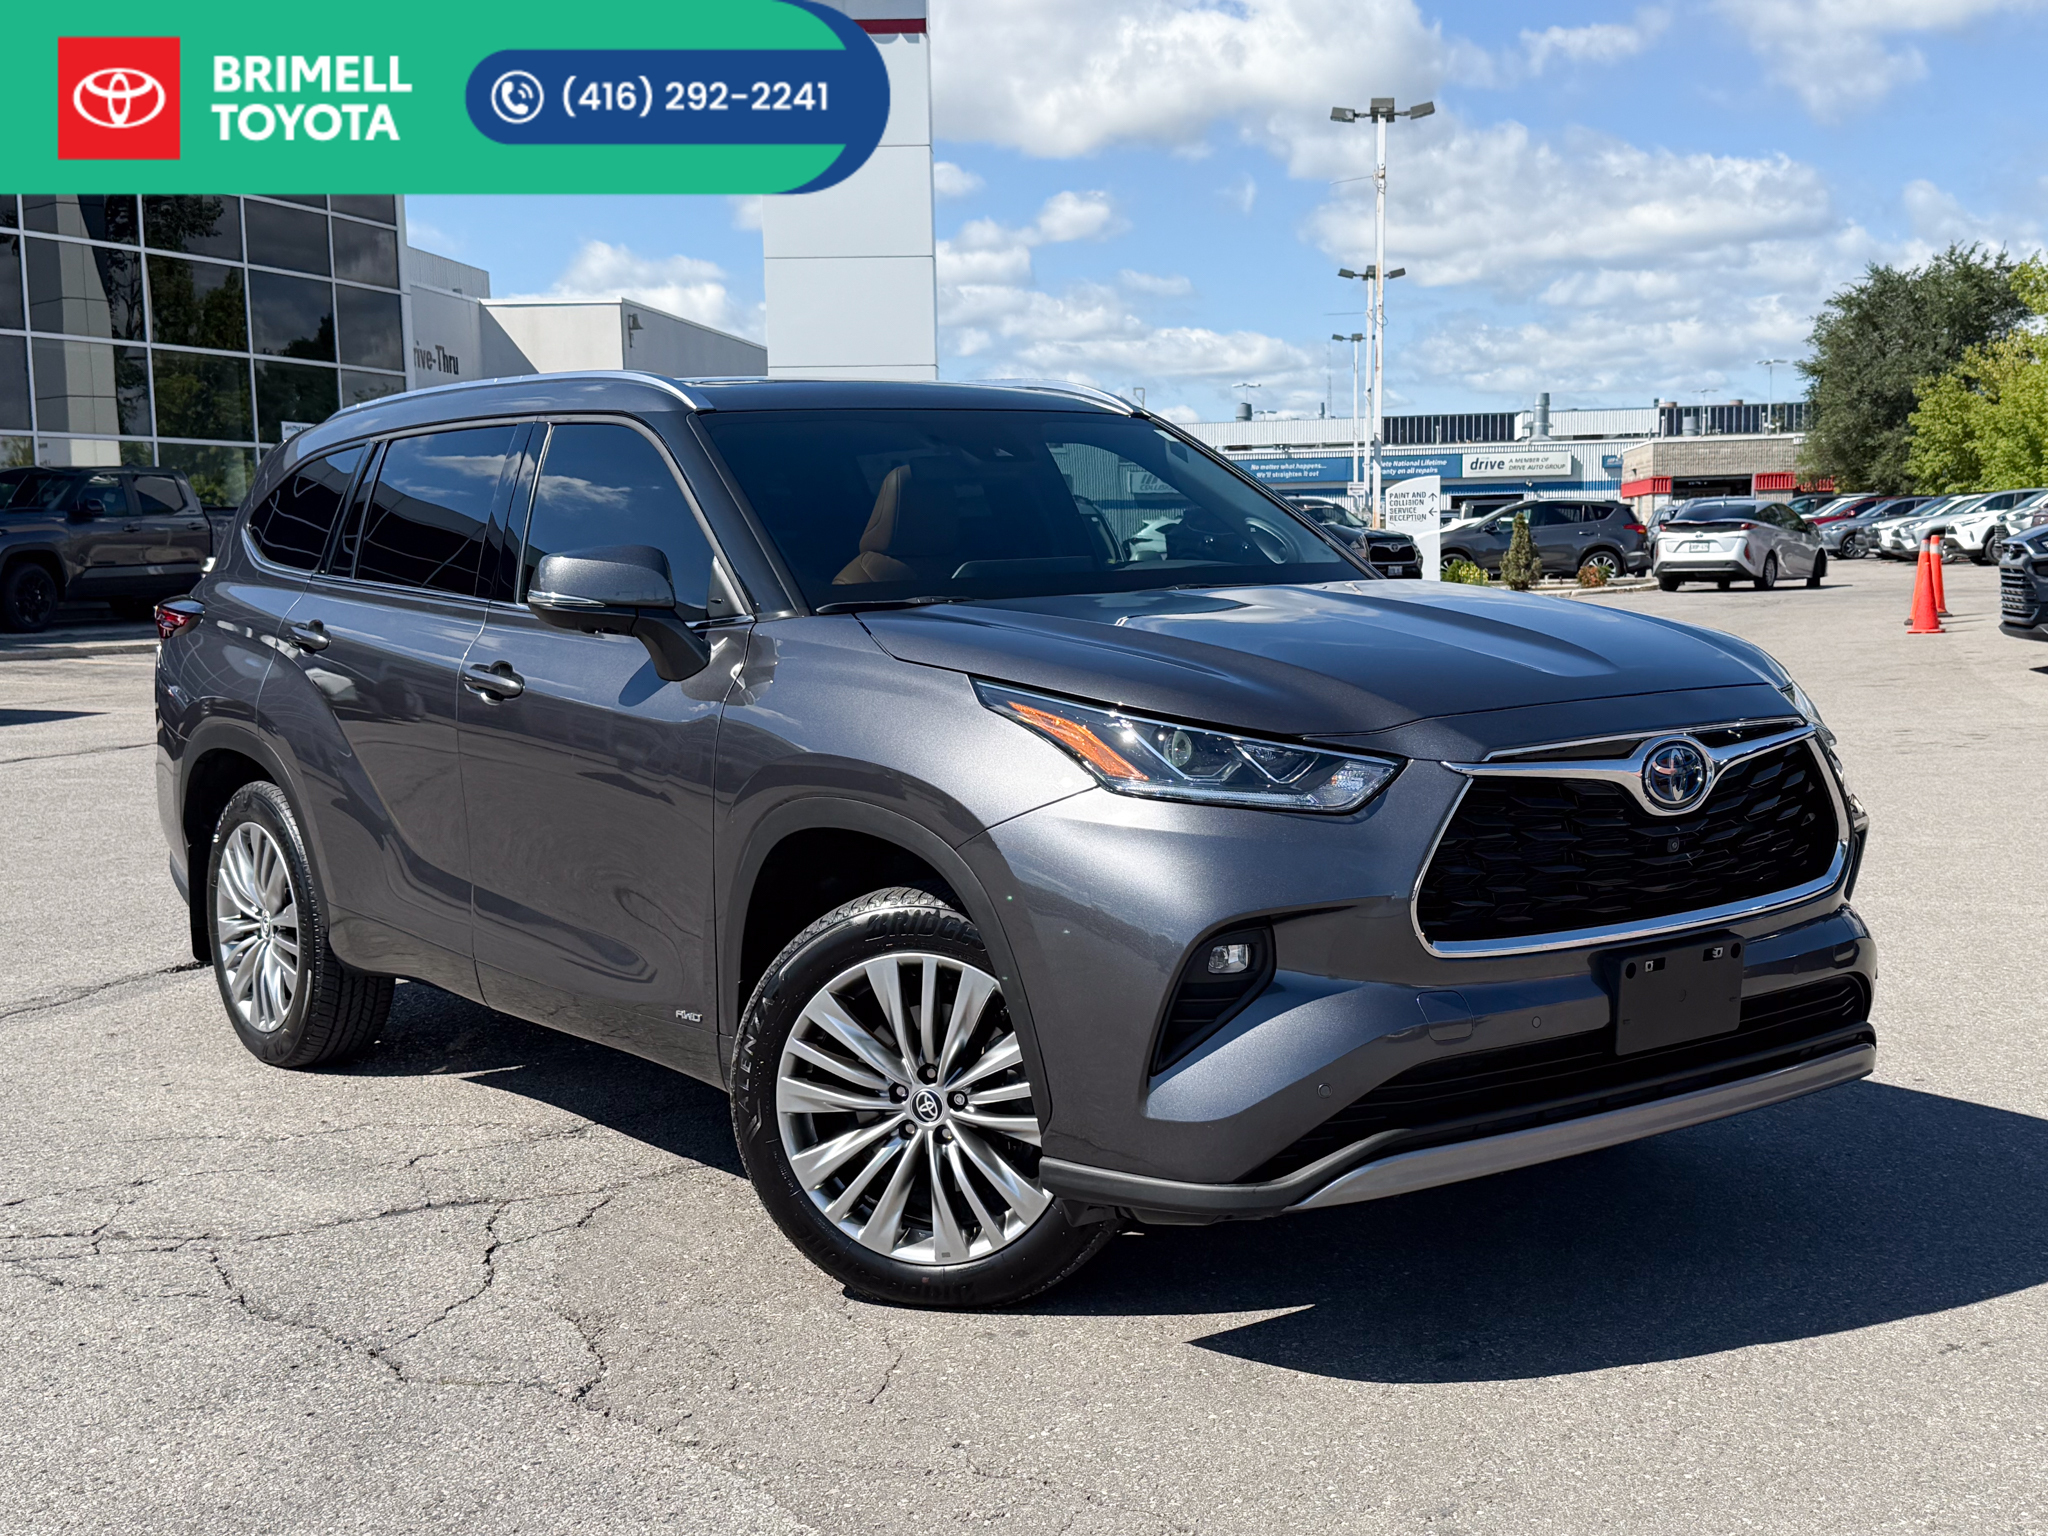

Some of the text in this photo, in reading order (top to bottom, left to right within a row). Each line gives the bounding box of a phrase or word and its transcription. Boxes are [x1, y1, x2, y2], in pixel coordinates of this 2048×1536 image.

[1470, 458, 1505, 470] drive
[1389, 514, 1427, 522] RECEPTION
[738, 997, 775, 1114] ALENZA
